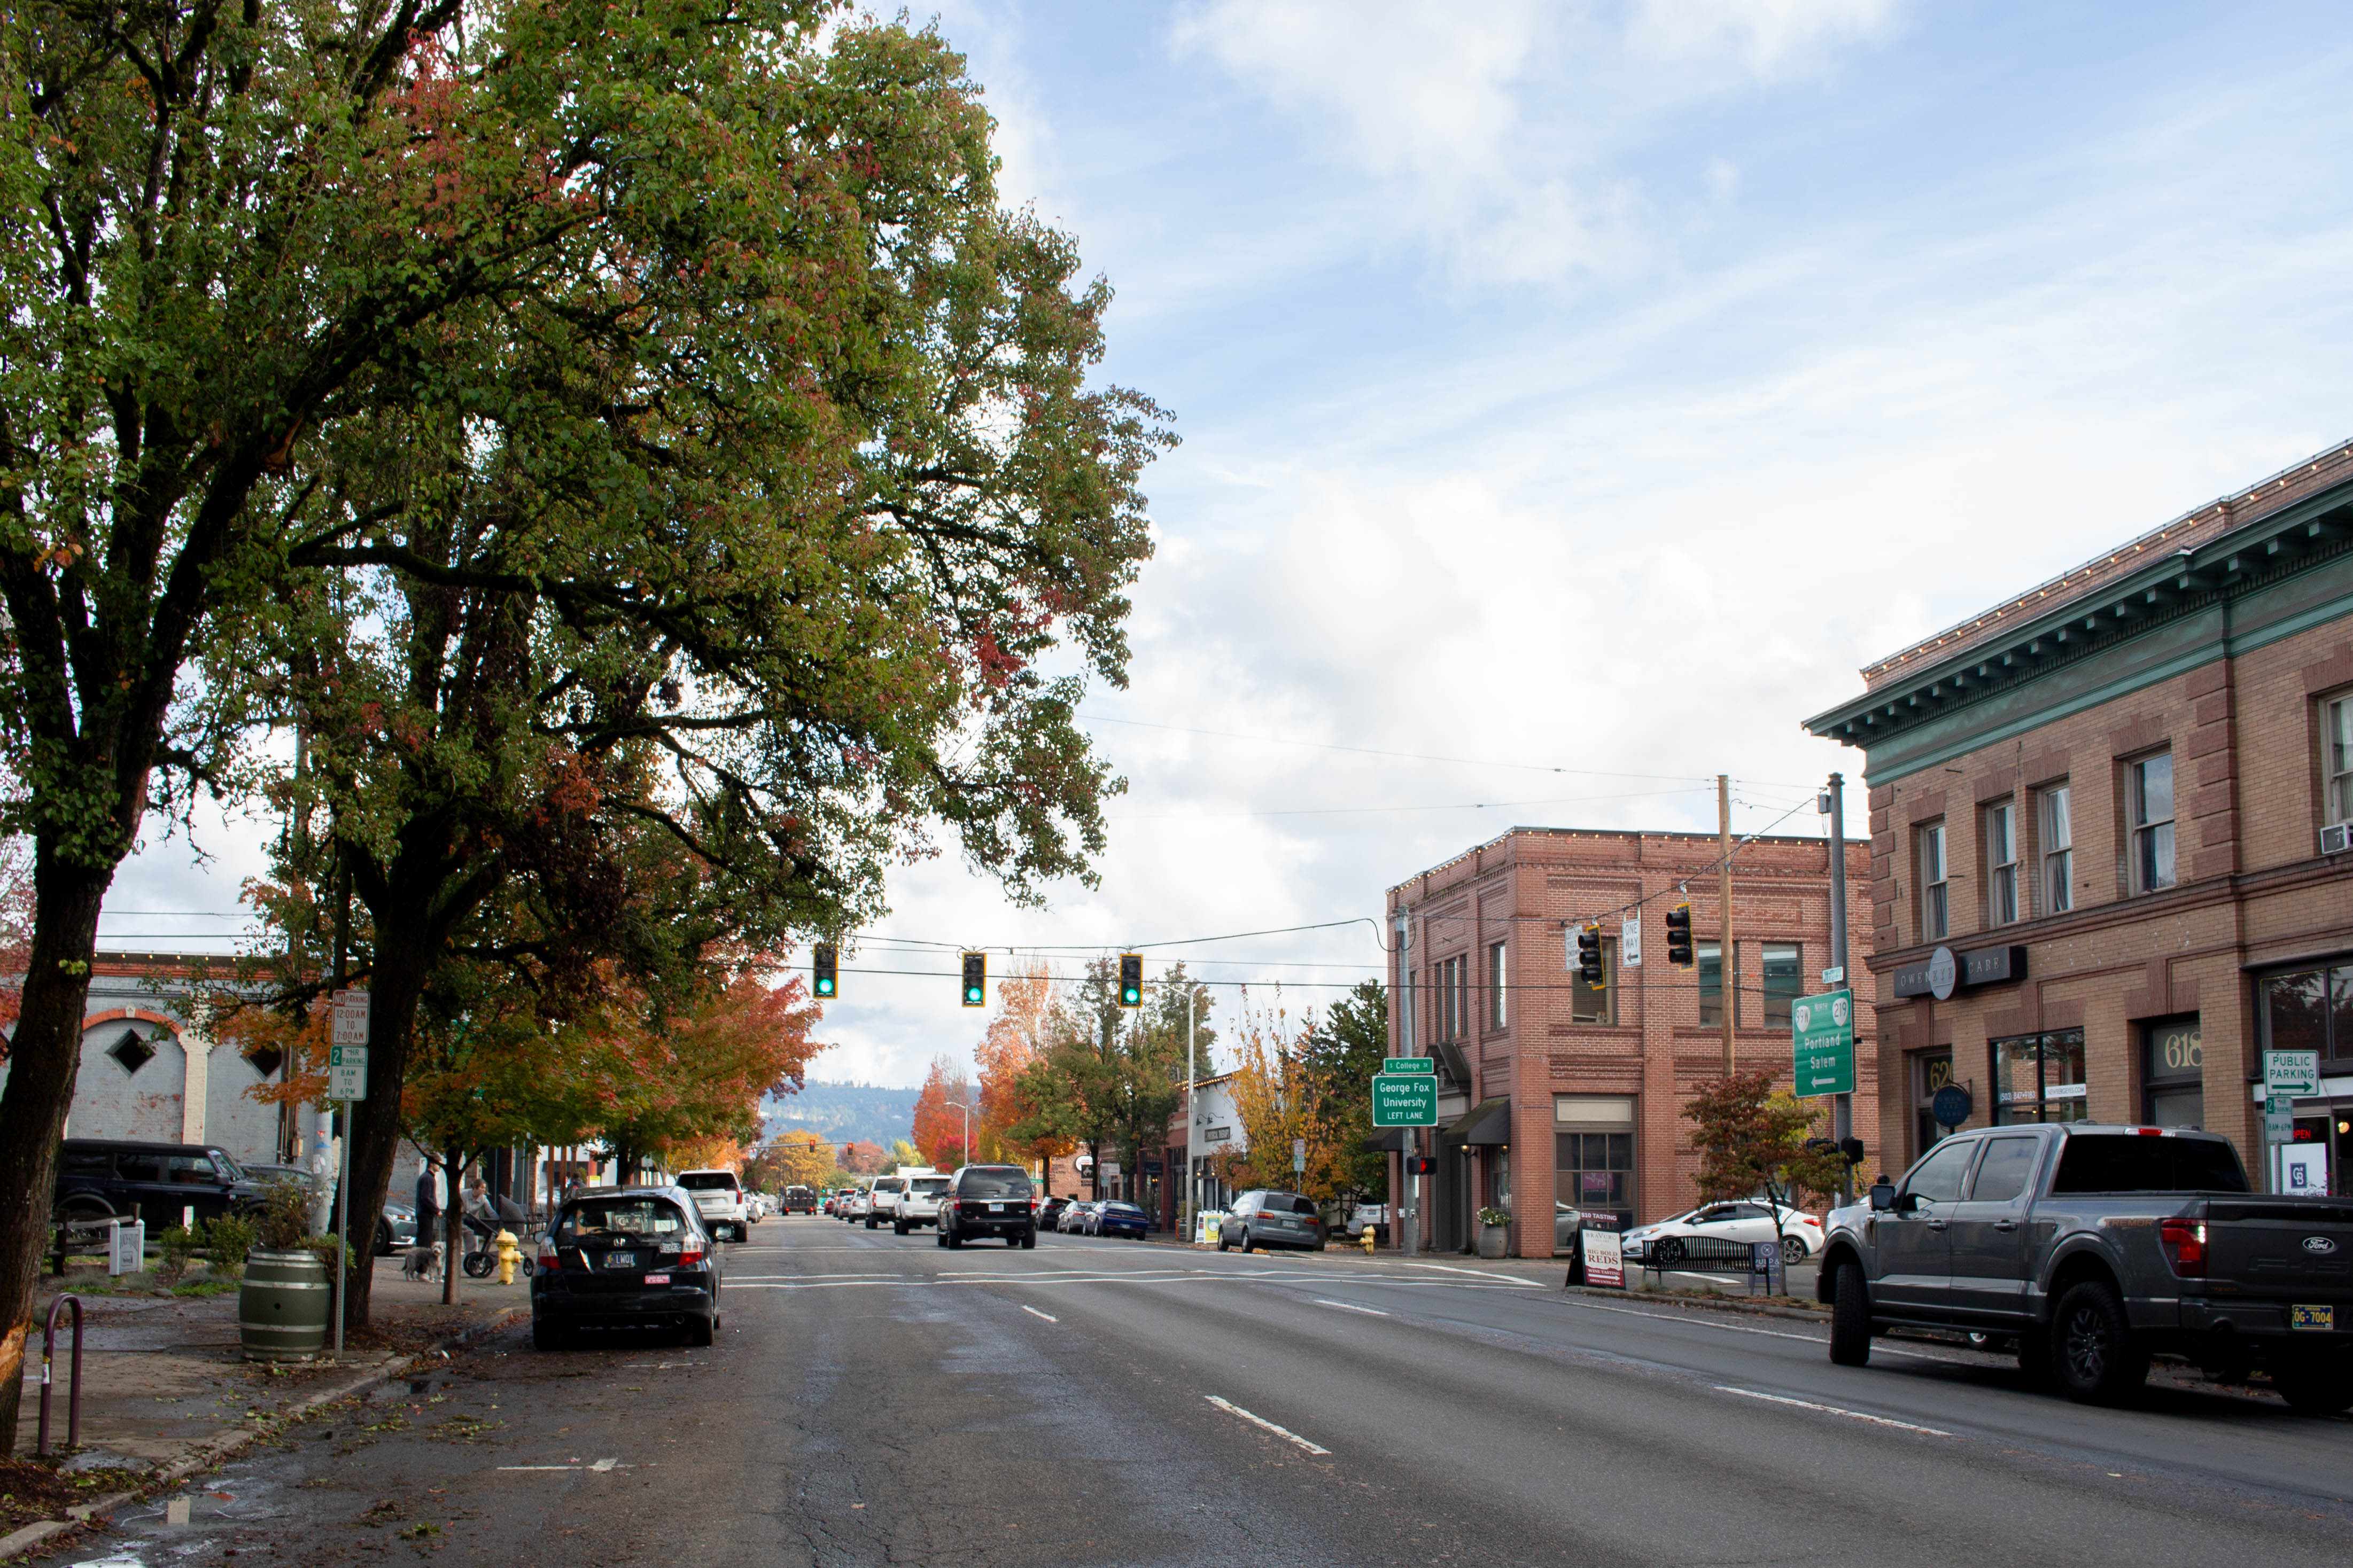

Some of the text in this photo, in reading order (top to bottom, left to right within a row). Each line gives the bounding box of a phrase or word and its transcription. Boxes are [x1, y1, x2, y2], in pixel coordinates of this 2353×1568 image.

[1626, 923, 1637, 935] ONE
[1625, 936, 1638, 949] WAY
[1900, 957, 2000, 987] OWEN EYE CARE
[336, 994, 367, 1005] NO PARKING
[1834, 1002, 1847, 1018] 219
[1796, 1010, 1808, 1023] 99W
[346, 1021, 355, 1029] TO
[1805, 1033, 1841, 1051] Portland
[2165, 1032, 2202, 1068] 618
[333, 1050, 339, 1063] 2
[1811, 1055, 1836, 1070] Salem
[2273, 1056, 2310, 1066] PUBLIC
[1396, 1062, 1420, 1071] College
[2270, 1070, 2315, 1079] PARKING
[1380, 1082, 1430, 1095] George Fox
[1383, 1097, 1427, 1109] University
[2000, 1092, 2012, 1103] (503)
[2268, 1099, 2273, 1112] 2
[2104, 1218, 2154, 1227] TREMOR
[2308, 1238, 2329, 1250] Ford
[1588, 1254, 1618, 1265] REDS
